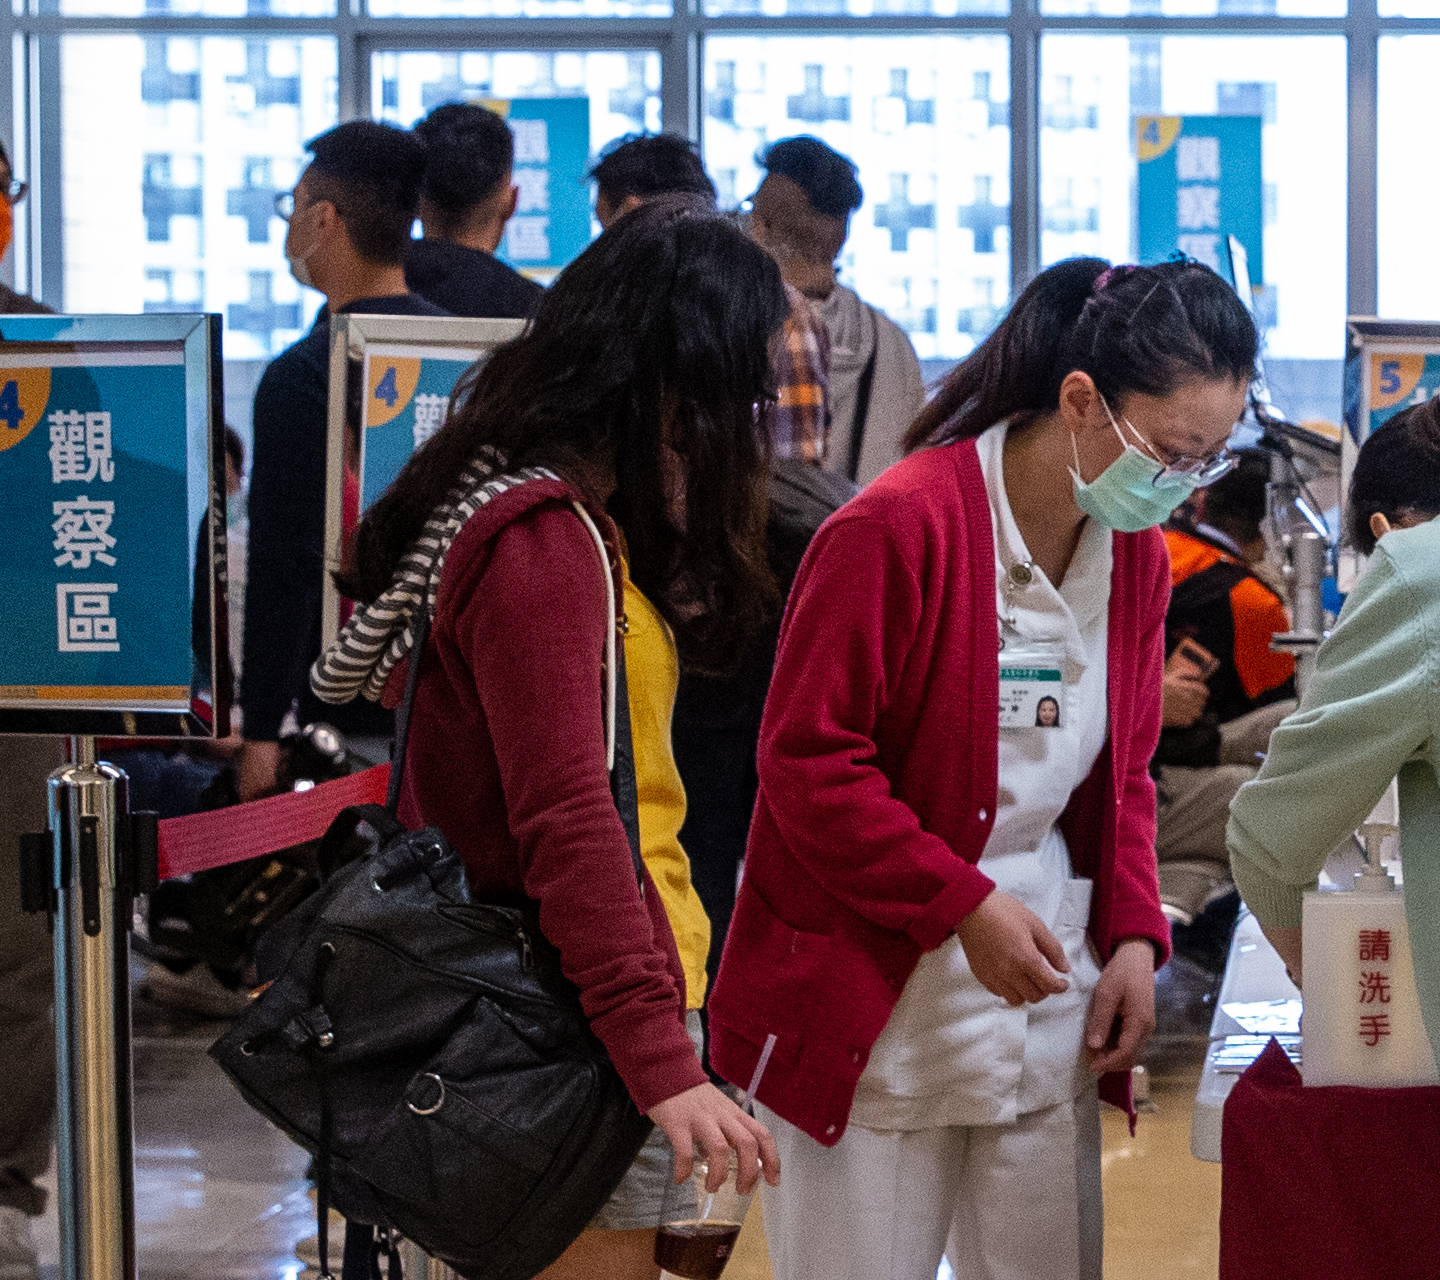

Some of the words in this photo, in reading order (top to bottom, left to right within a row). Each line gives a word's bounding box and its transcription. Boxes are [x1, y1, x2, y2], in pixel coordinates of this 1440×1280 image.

[374, 366, 399, 408] 4
[1379, 360, 1402, 395] 5
[47, 408, 121, 653] 觀察區
[1358, 929, 1391, 1048] 請洗手
